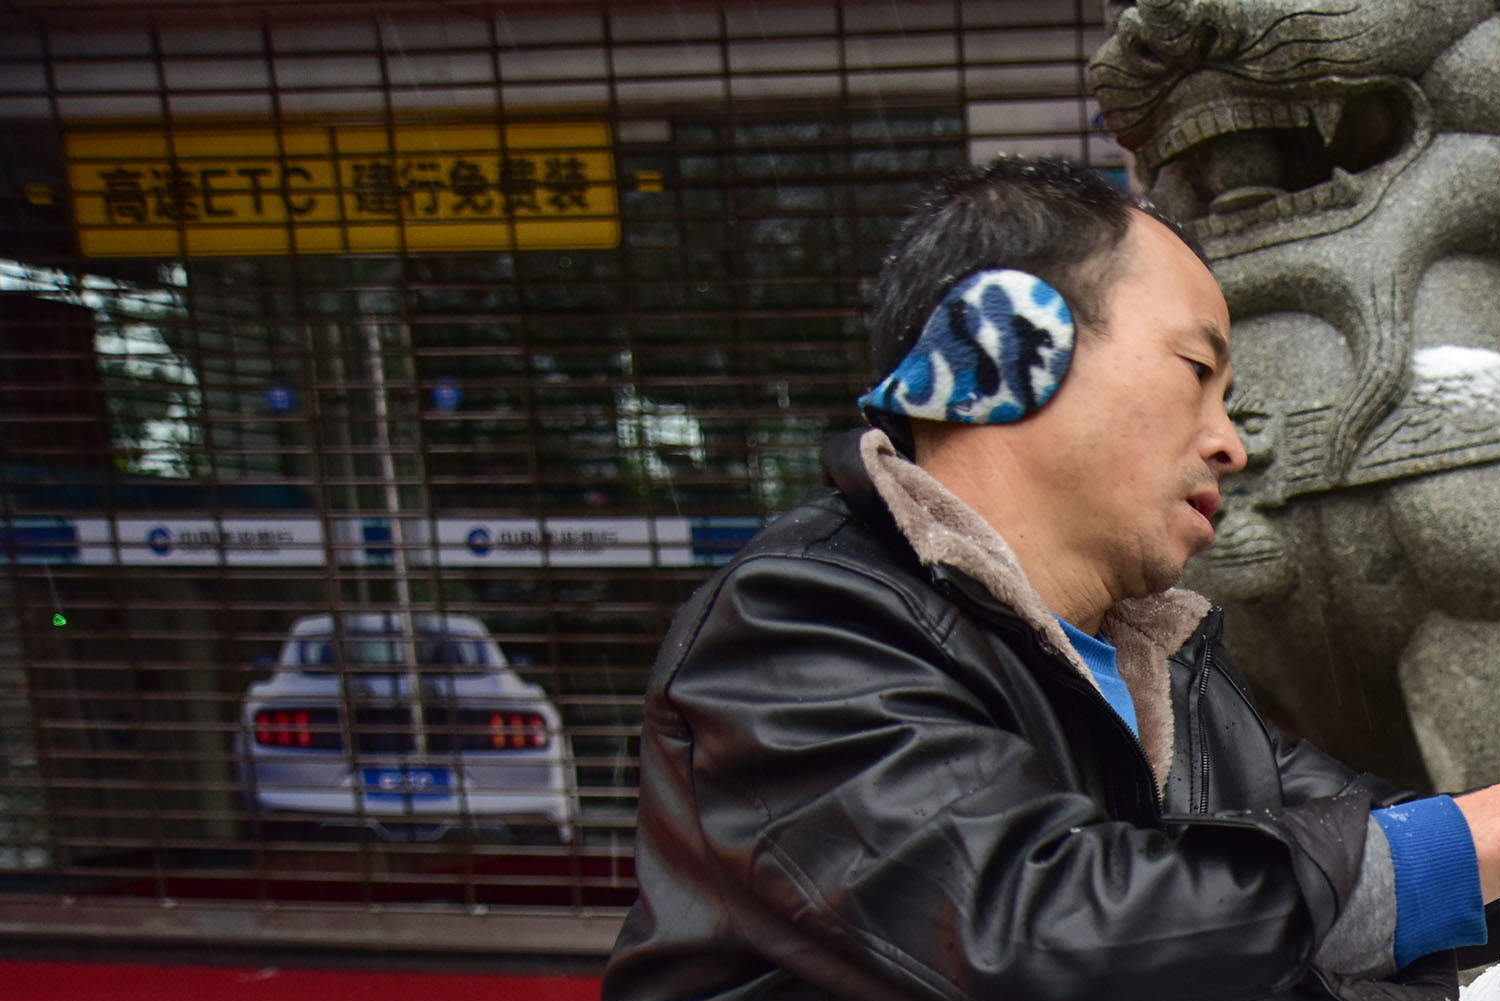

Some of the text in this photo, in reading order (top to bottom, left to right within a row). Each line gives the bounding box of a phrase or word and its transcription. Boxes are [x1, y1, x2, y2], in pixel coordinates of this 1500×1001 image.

[100, 157, 590, 224] 高速ETC 建行免费装
